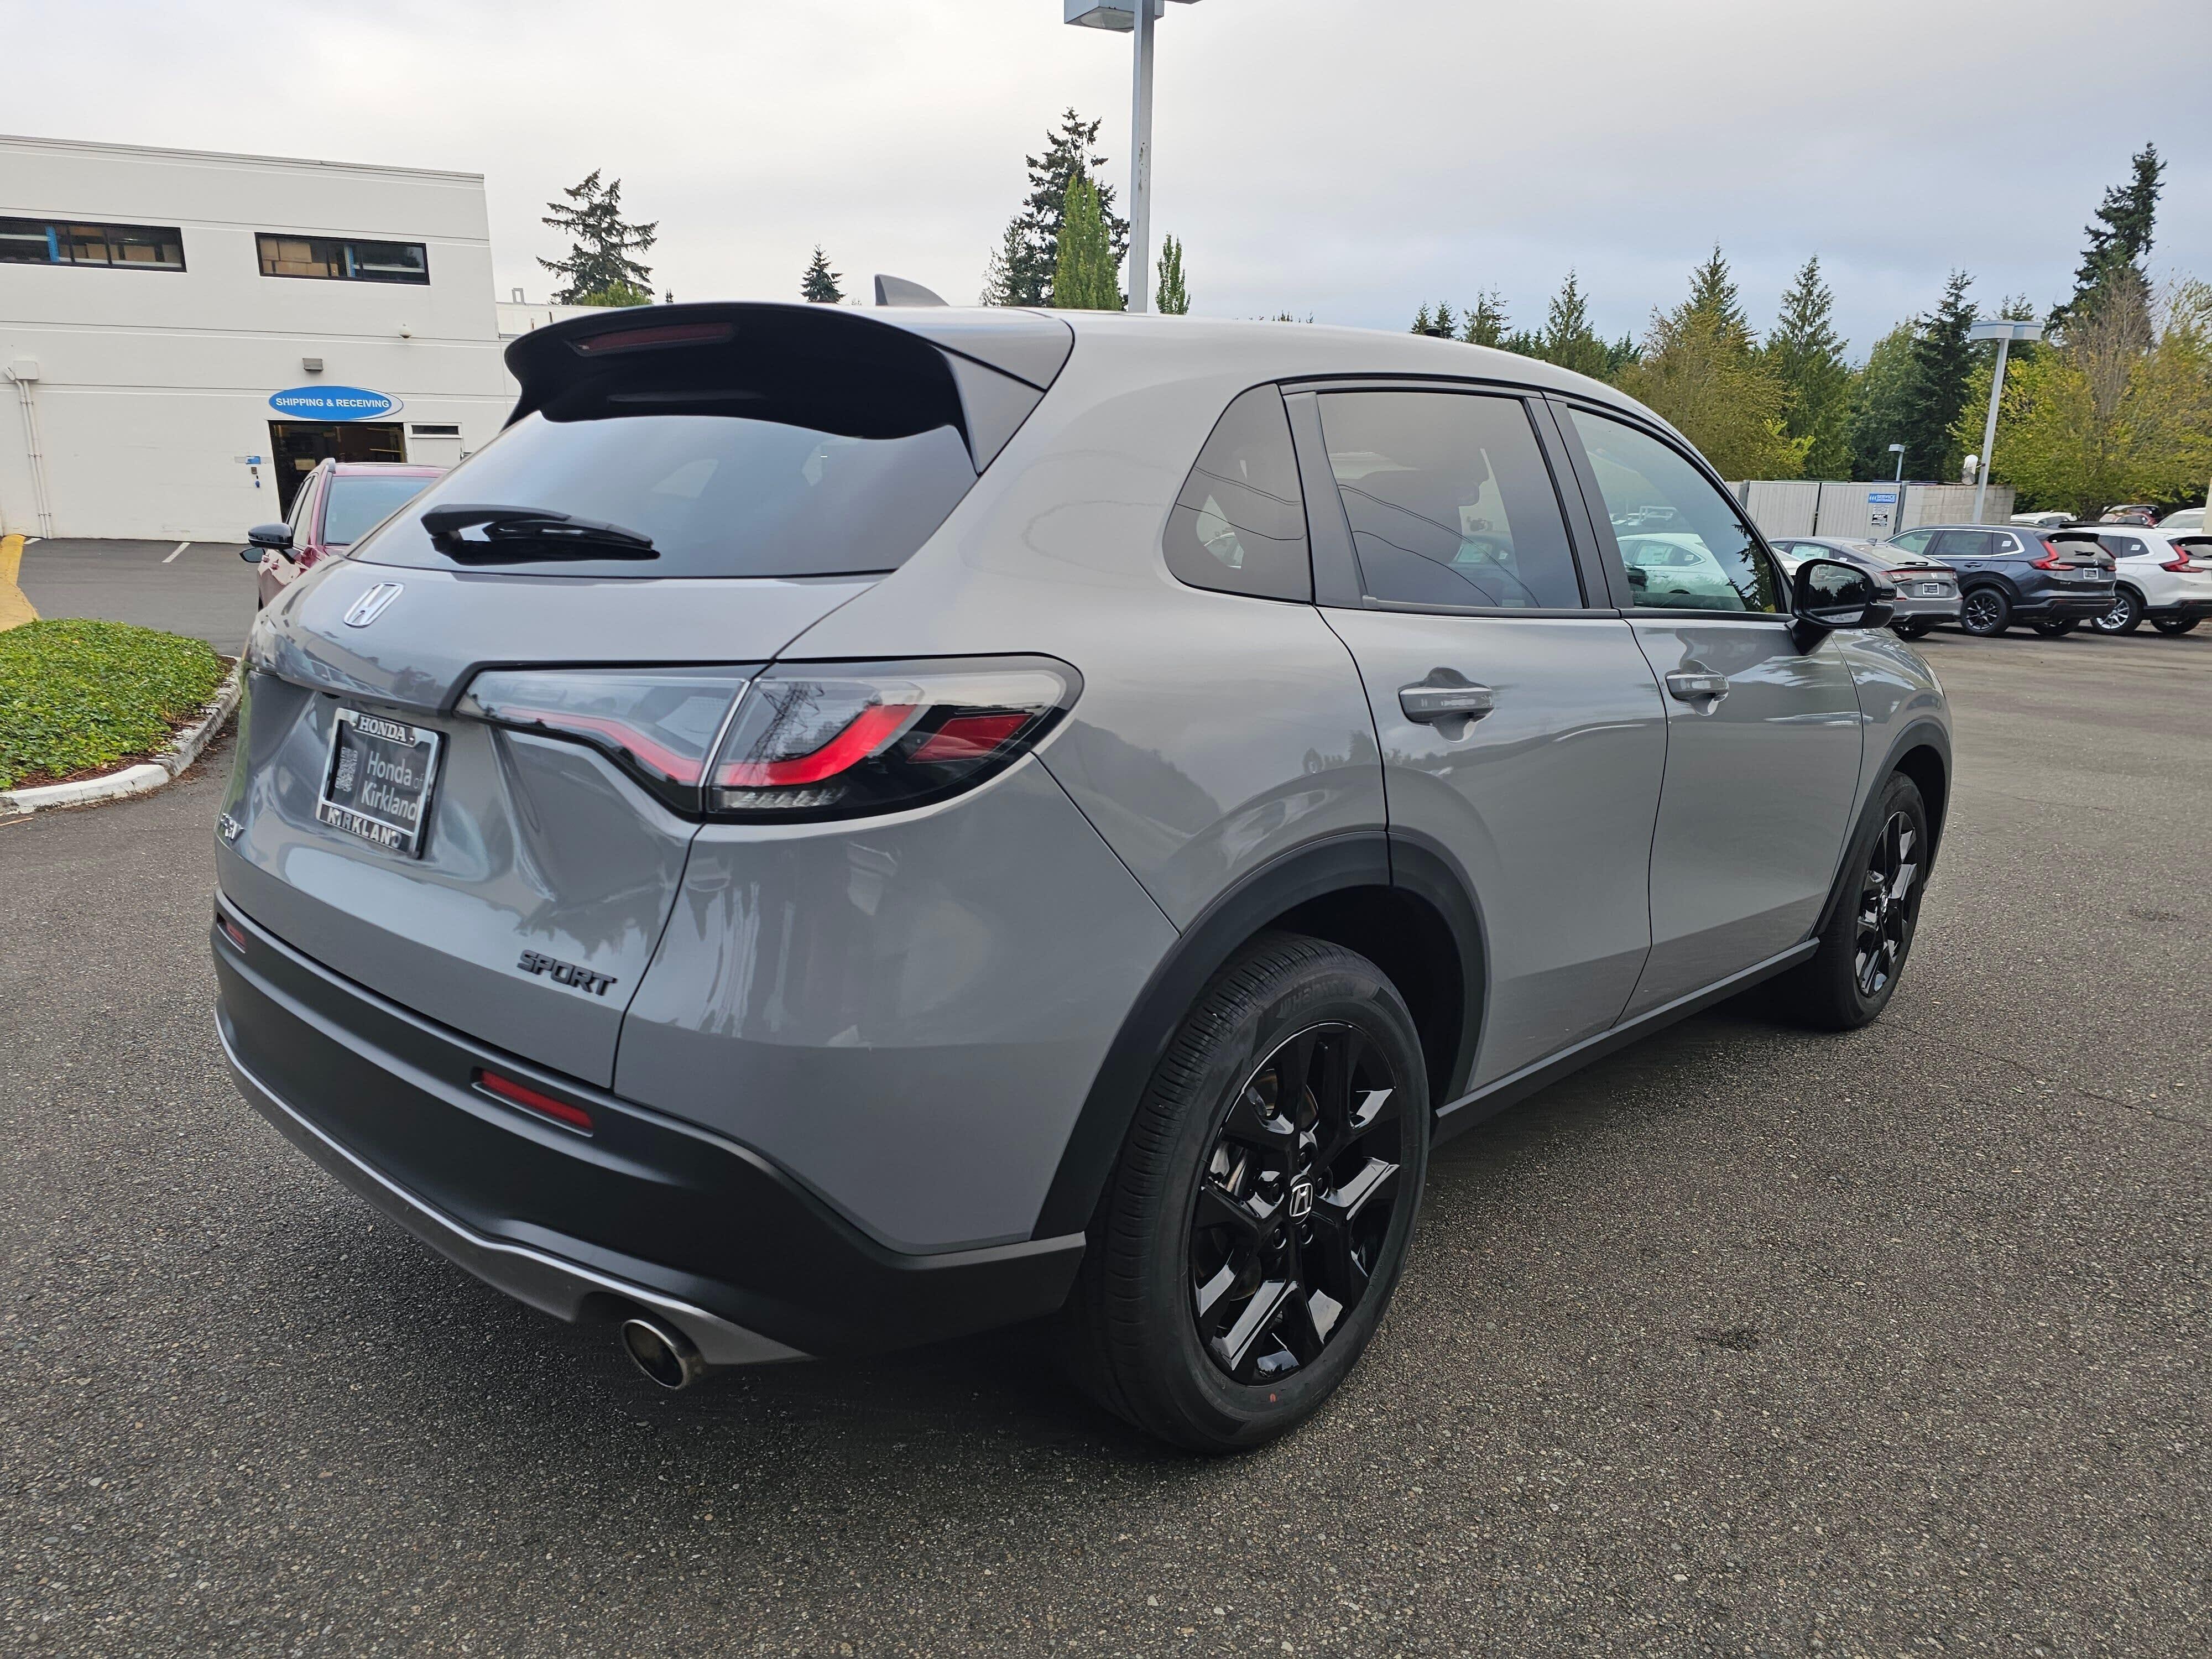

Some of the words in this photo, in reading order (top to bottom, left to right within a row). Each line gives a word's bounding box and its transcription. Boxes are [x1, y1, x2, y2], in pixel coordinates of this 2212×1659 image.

[276, 398, 323, 407] SHIPPING
[326, 399, 334, 408] &
[336, 399, 389, 409] RECEIVING
[359, 716, 406, 743] HONDA
[367, 750, 413, 787] Honda
[361, 780, 421, 822] Kirkland
[327, 807, 403, 849] KIRKLAND
[517, 949, 619, 997] SPORT
